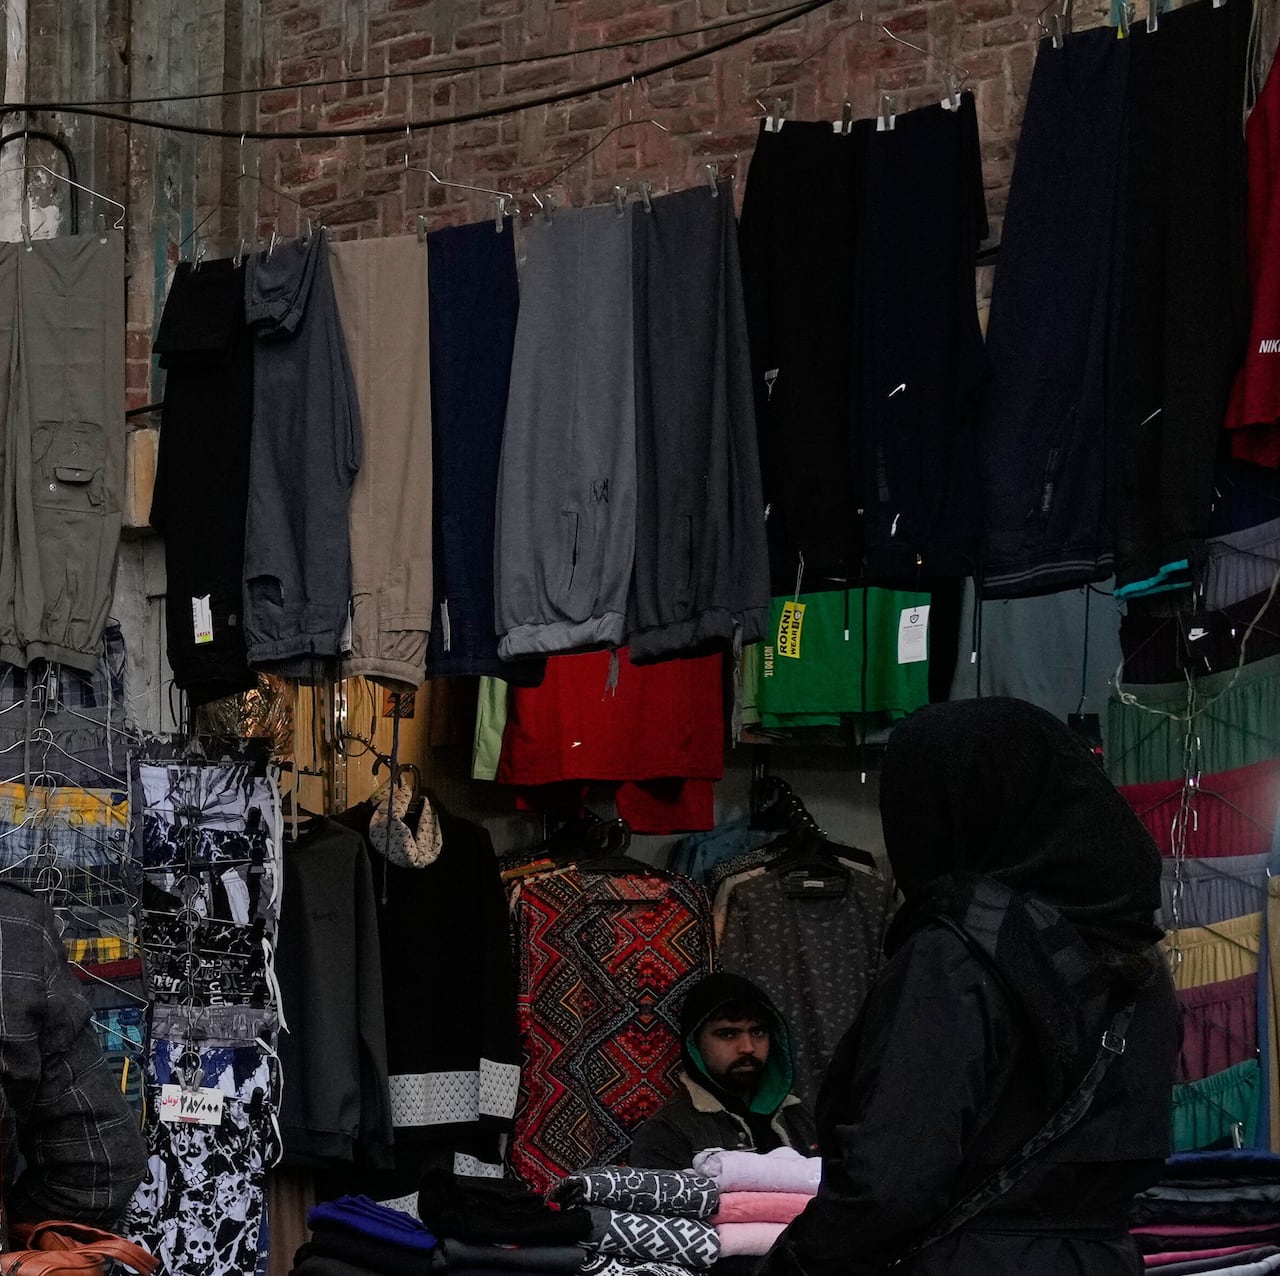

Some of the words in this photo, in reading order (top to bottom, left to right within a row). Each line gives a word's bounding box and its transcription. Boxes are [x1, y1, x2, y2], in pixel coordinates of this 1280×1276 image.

[1259, 340, 1280, 353] NIK
[780, 609, 793, 655] ROKNI
[790, 630, 798, 656] WEAR
